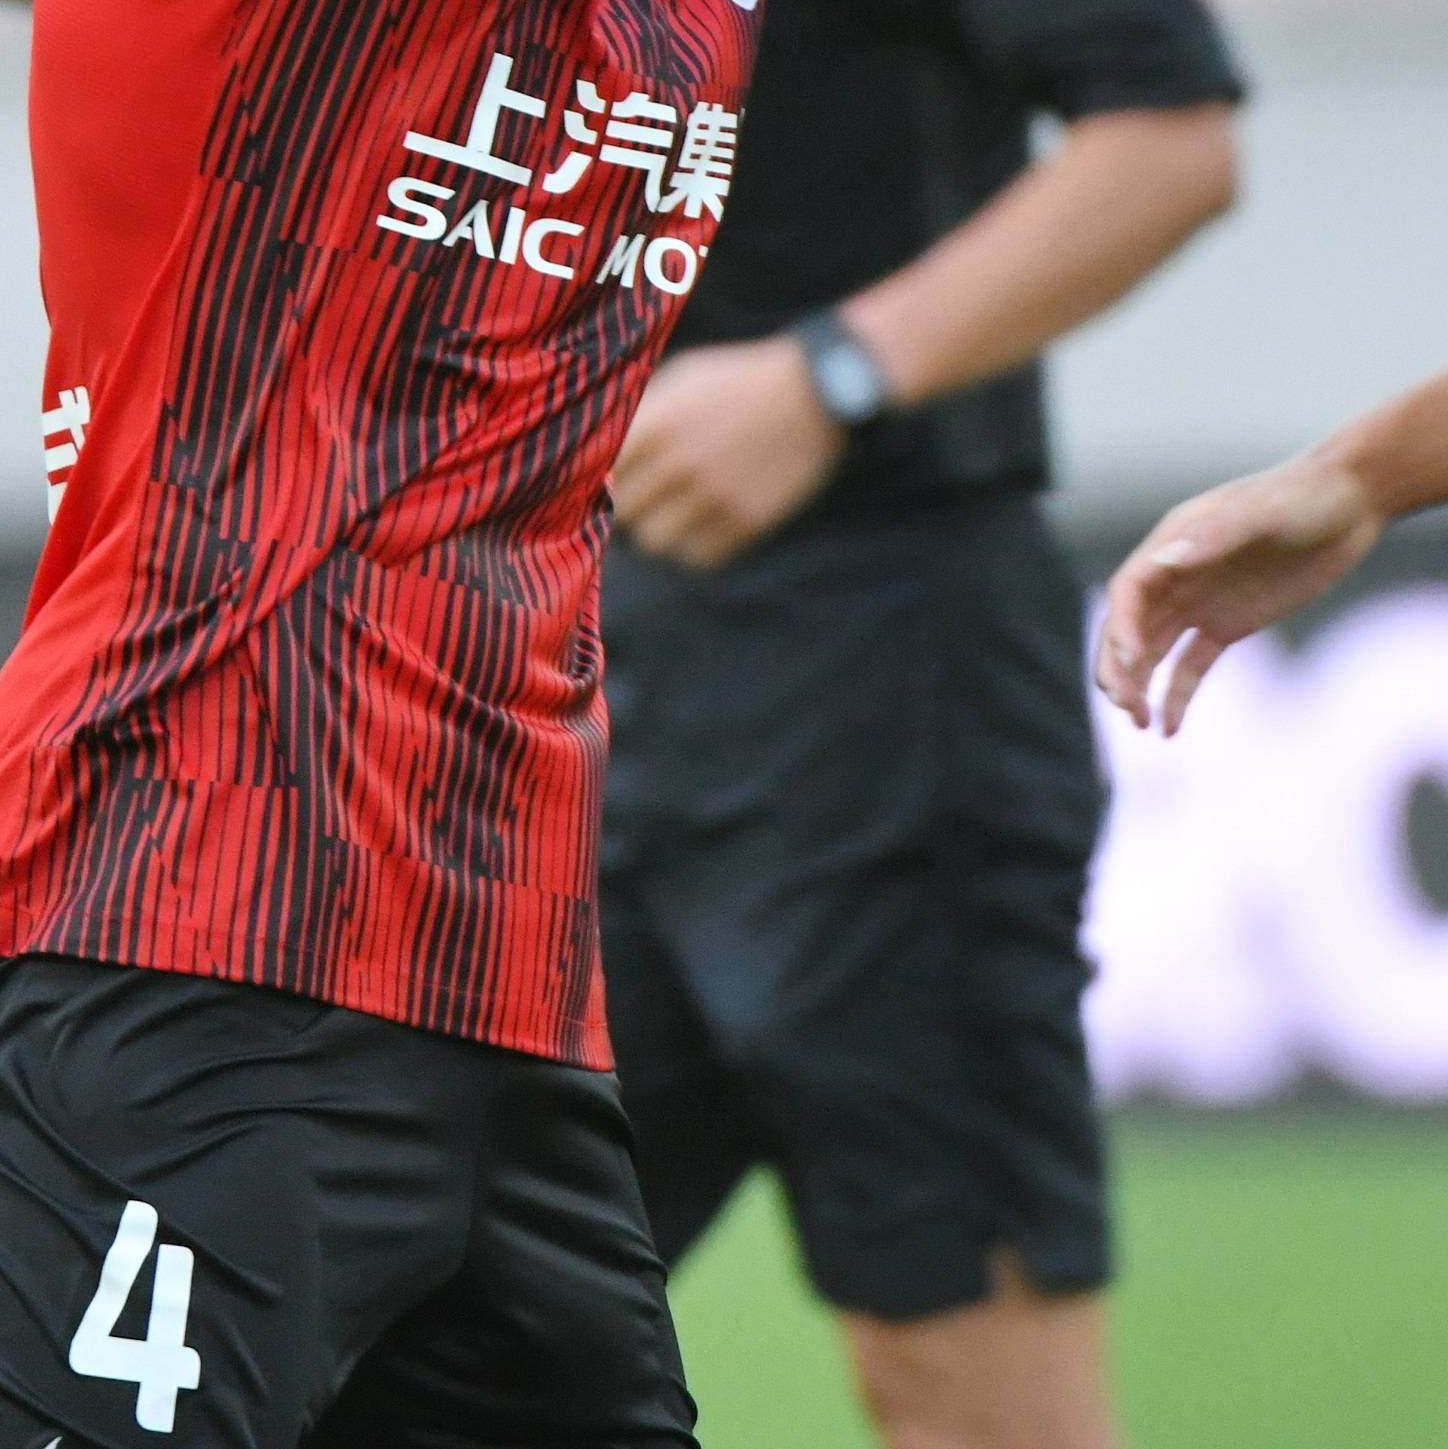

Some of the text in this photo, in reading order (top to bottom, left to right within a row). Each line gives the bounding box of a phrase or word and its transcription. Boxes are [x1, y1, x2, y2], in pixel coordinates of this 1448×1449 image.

[403, 52, 745, 223] 上汽集
[376, 176, 709, 296] SAIC MO
[69, 1199, 201, 1433] 4
